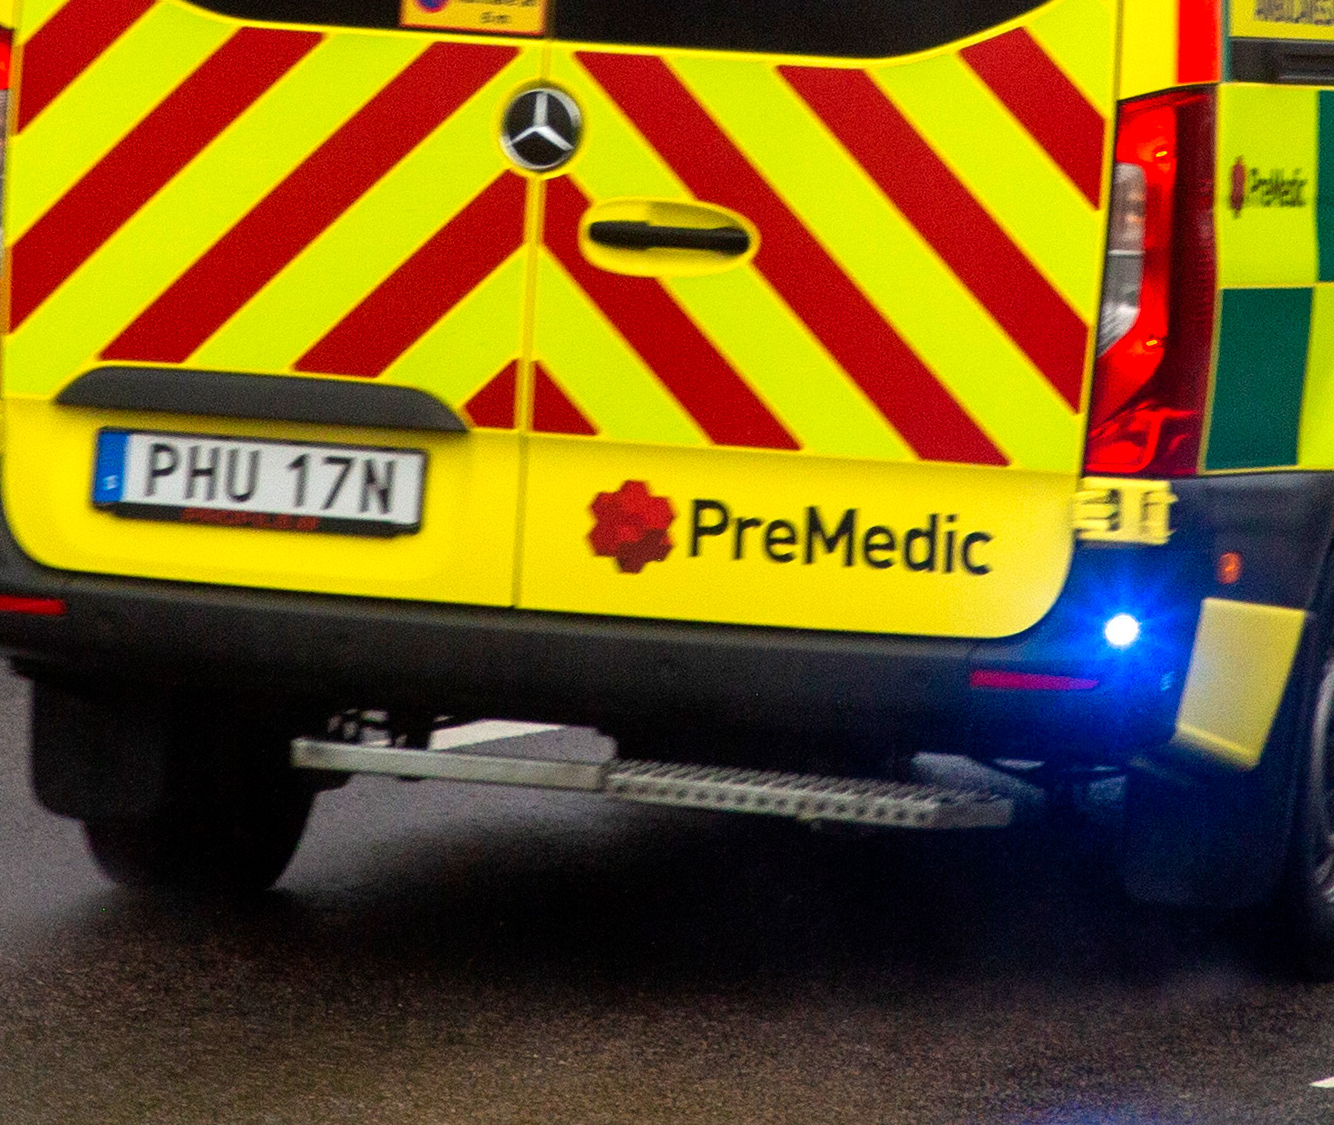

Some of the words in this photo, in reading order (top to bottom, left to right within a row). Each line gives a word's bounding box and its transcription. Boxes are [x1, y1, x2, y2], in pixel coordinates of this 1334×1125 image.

[143, 441, 262, 503] PHU
[286, 451, 398, 516] 17N
[687, 498, 994, 576] PreMedic
